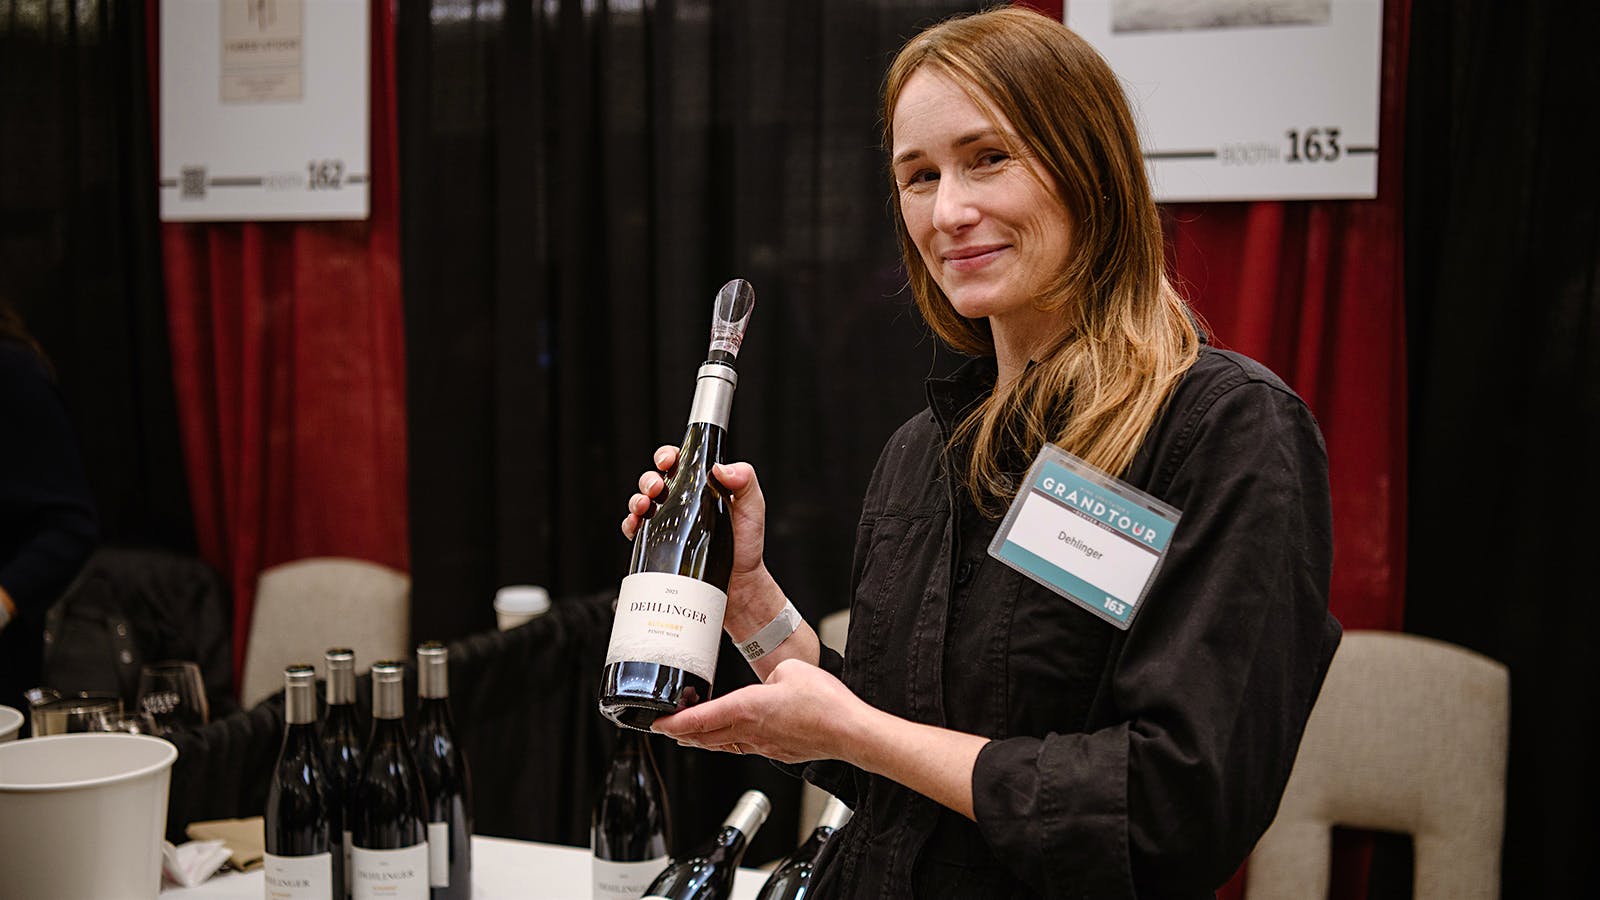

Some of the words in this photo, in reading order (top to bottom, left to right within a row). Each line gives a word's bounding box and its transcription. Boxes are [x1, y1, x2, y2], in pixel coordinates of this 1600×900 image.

[1285, 127, 1342, 163] 163
[307, 159, 345, 190] 162
[1042, 477, 1106, 516] GRAND
[1109, 509, 1157, 544] TOUR
[1057, 530, 1104, 560] Dehlinger
[630, 601, 707, 625] DEHLINGER
[1103, 597, 1127, 616] 163
